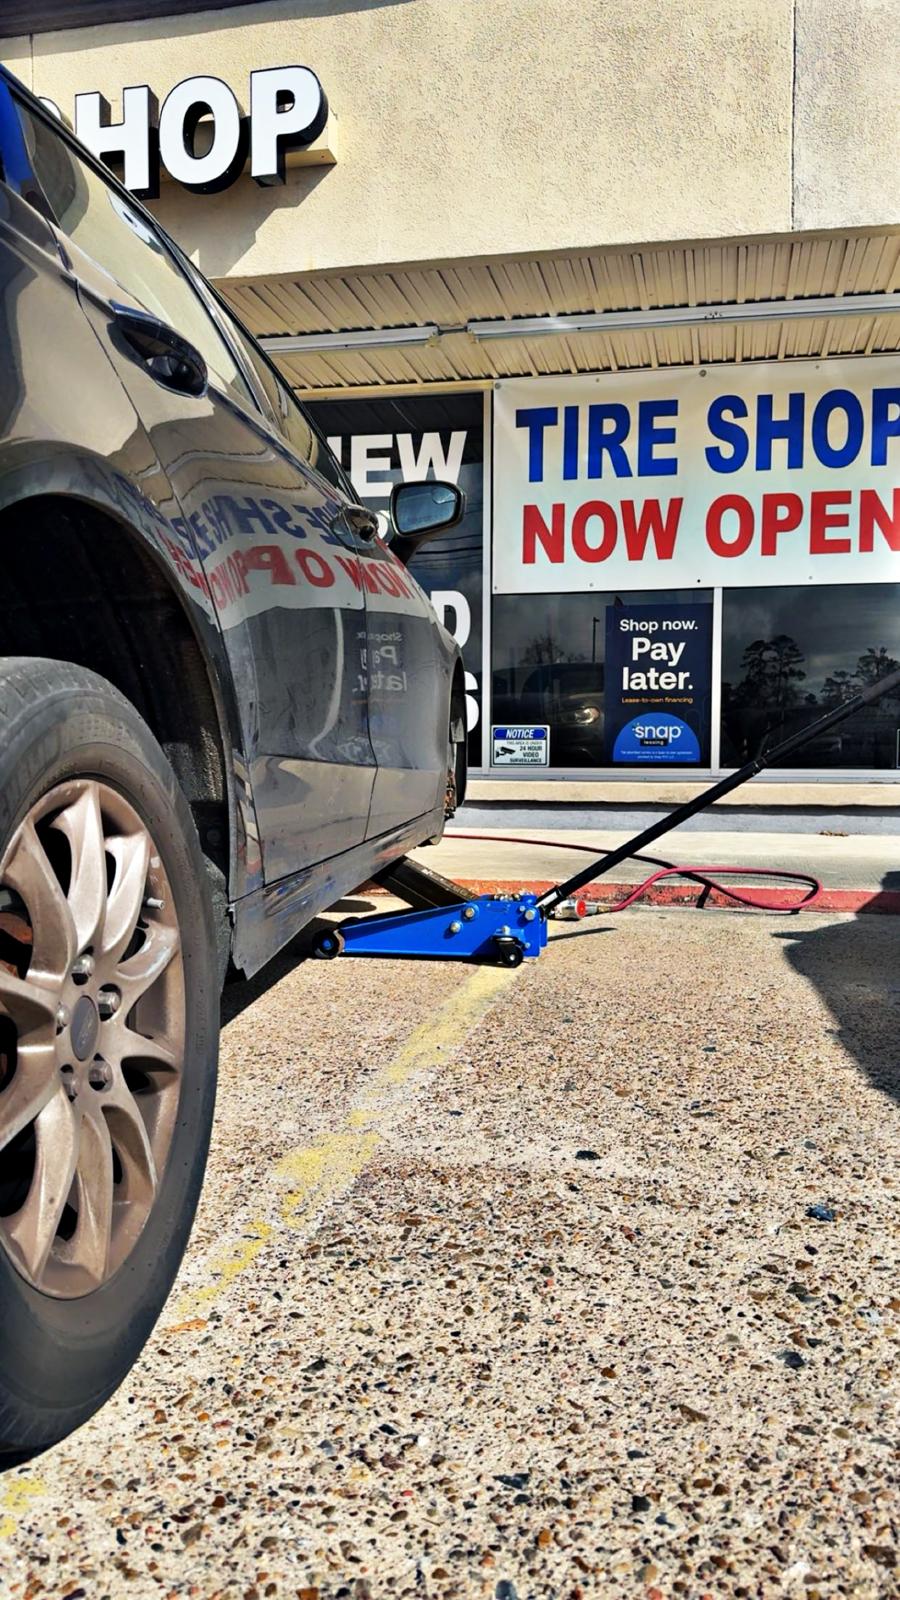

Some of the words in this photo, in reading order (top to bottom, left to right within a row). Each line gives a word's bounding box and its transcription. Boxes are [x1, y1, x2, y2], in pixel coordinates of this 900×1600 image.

[38, 65, 322, 192] HOP
[515, 399, 678, 482] TIRE
[704, 387, 900, 474] SHOP
[522, 497, 684, 564] NOW
[705, 487, 900, 558] OPEN
[619, 619, 659, 633] Shop
[662, 619, 698, 631] now.
[632, 637, 686, 667] Pay
[622, 667, 693, 691] later.
[506, 729, 534, 738] NOTICE
[634, 725, 681, 744] snap
